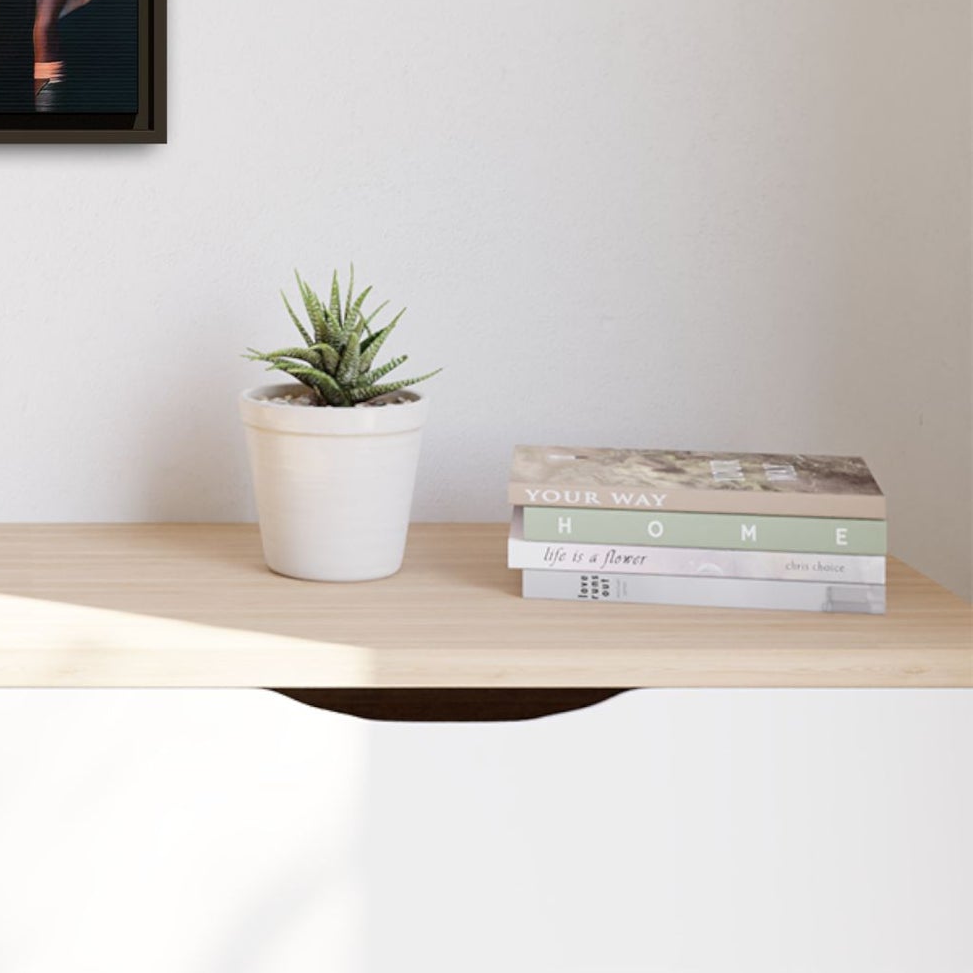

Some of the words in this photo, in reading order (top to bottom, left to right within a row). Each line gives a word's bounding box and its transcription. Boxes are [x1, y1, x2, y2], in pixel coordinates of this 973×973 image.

[525, 489, 600, 504] YOUR
[612, 492, 667, 506] WAY
[543, 546, 567, 567] life
[572, 550, 584, 563] is
[589, 553, 598, 564] a
[601, 548, 648, 569] flower
[785, 560, 809, 571] chris
[812, 561, 845, 573] choice
[578, 575, 588, 598] love
[591, 575, 599, 599] runs
[601, 578, 610, 597] out
